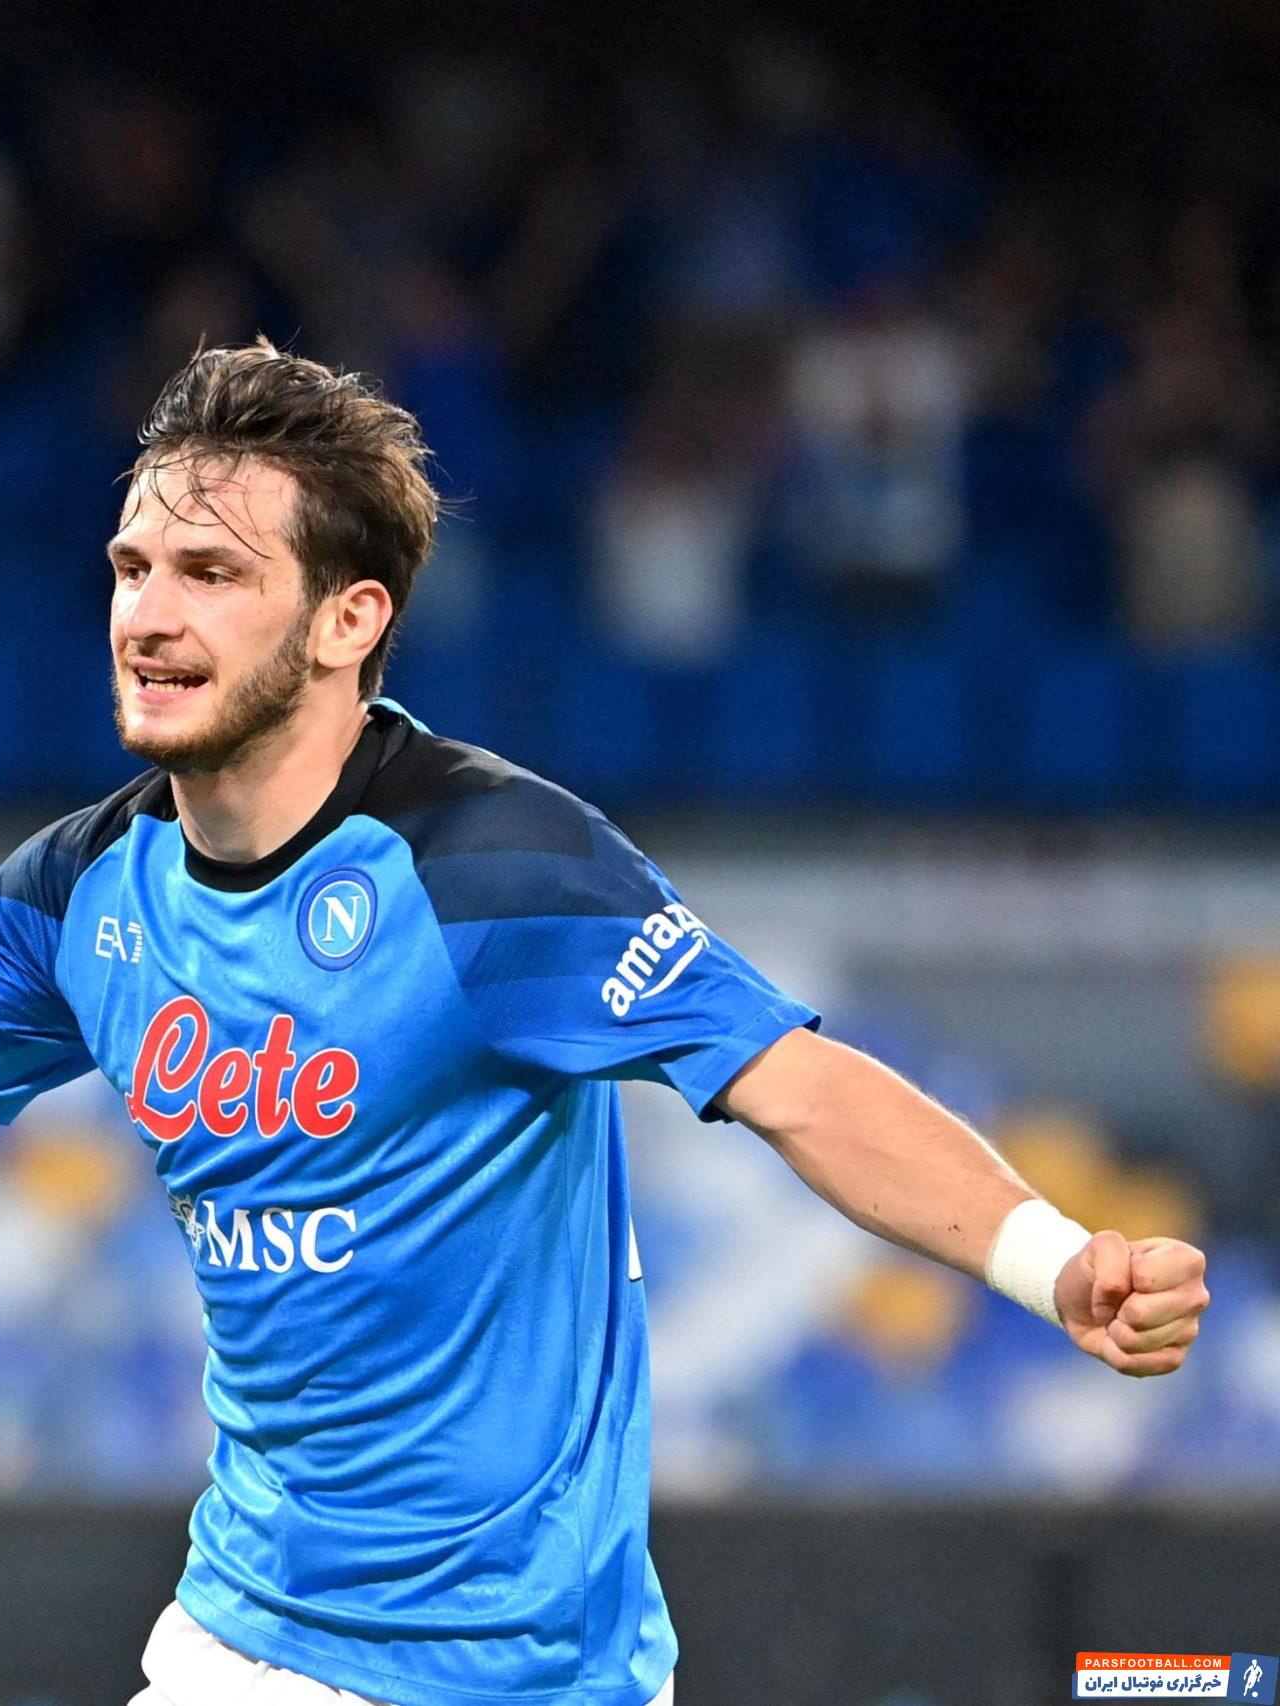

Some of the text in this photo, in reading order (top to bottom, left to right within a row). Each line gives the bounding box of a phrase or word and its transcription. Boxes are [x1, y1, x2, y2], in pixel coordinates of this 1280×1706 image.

[321, 895, 362, 942] N
[125, 995, 359, 1143] Lete
[202, 1200, 357, 1274] MSC
